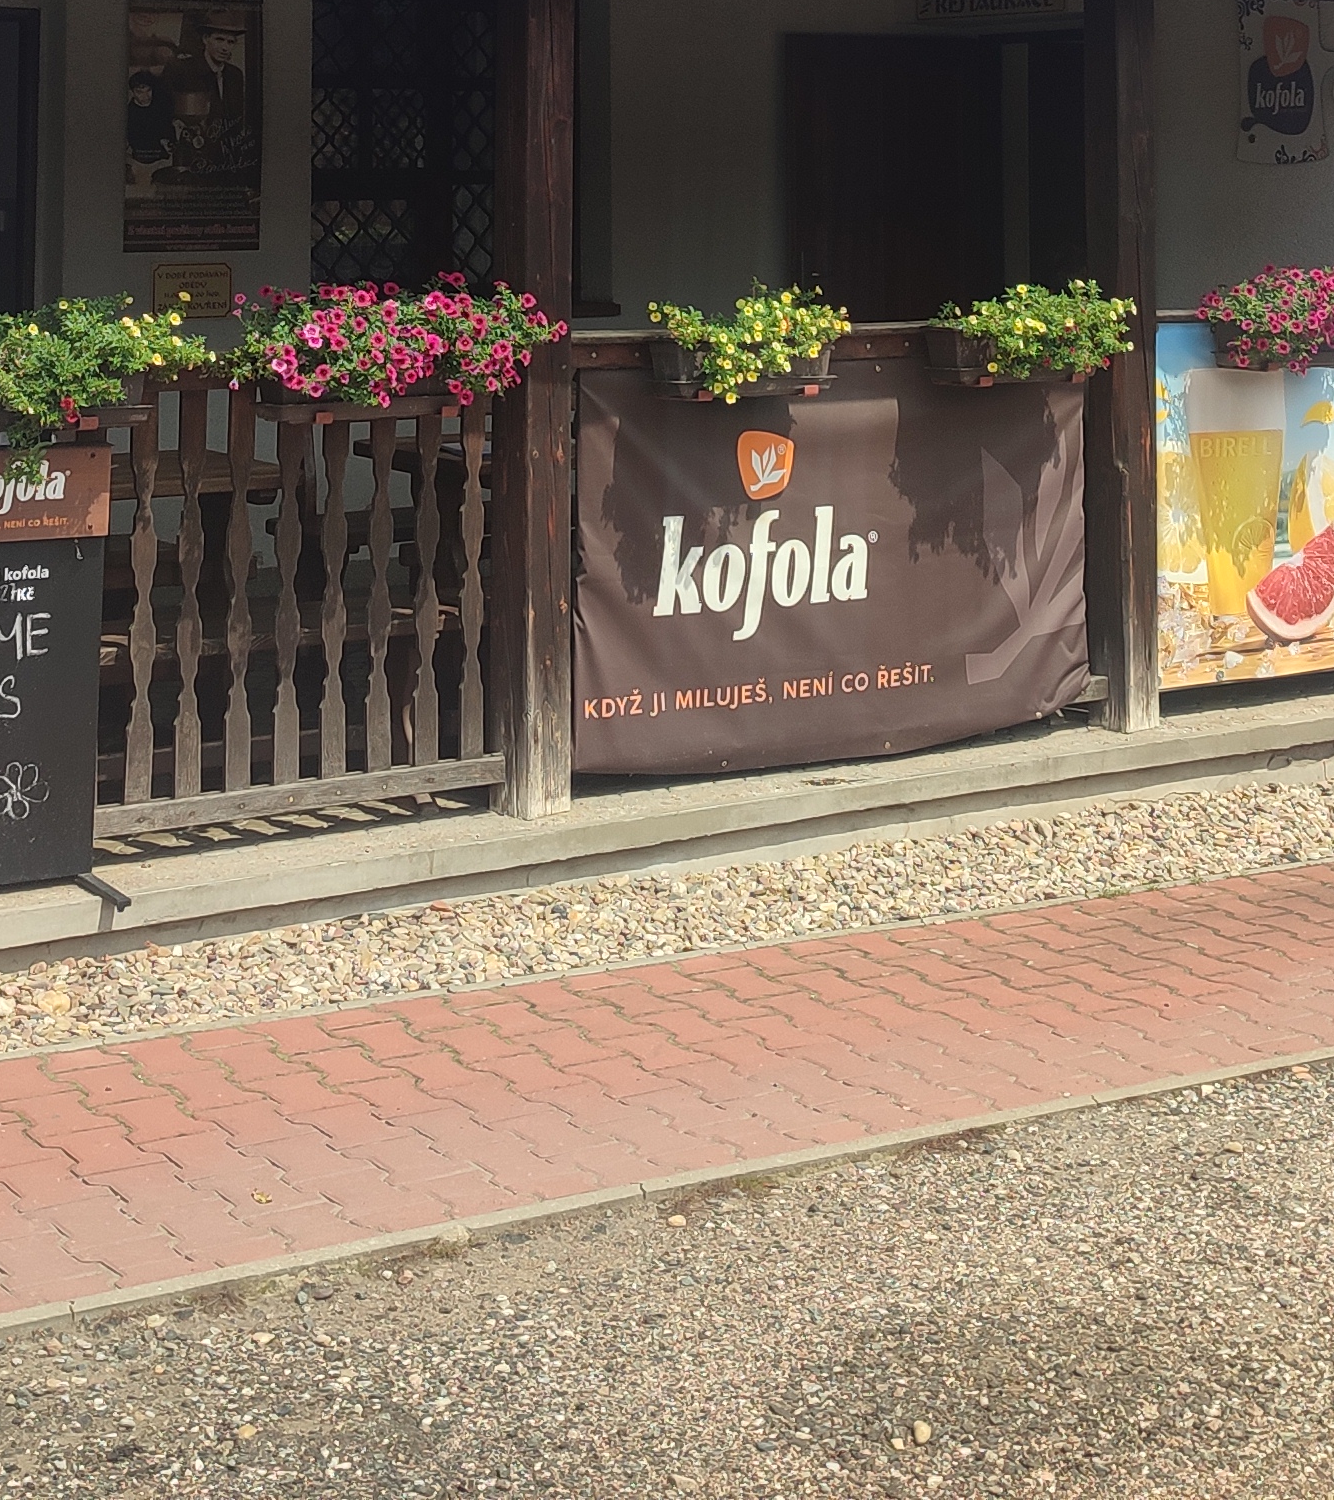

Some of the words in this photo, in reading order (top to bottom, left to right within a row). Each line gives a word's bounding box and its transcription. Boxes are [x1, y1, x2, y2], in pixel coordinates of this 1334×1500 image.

[1255, 81, 1305, 115] kofola
[1200, 433, 1272, 459] BIRELL
[3, 518, 25, 529] NENÍ
[28, 519, 41, 528] CO
[4, 564, 50, 581] kofola
[653, 505, 868, 641] kofola
[583, 688, 644, 720] KDYŽ
[649, 690, 666, 717] JI
[675, 677, 773, 711] MILUJEŠ,
[783, 670, 834, 700] NENÍ
[841, 672, 869, 693] CO
[877, 661, 935, 690] ŘEŠIT.
